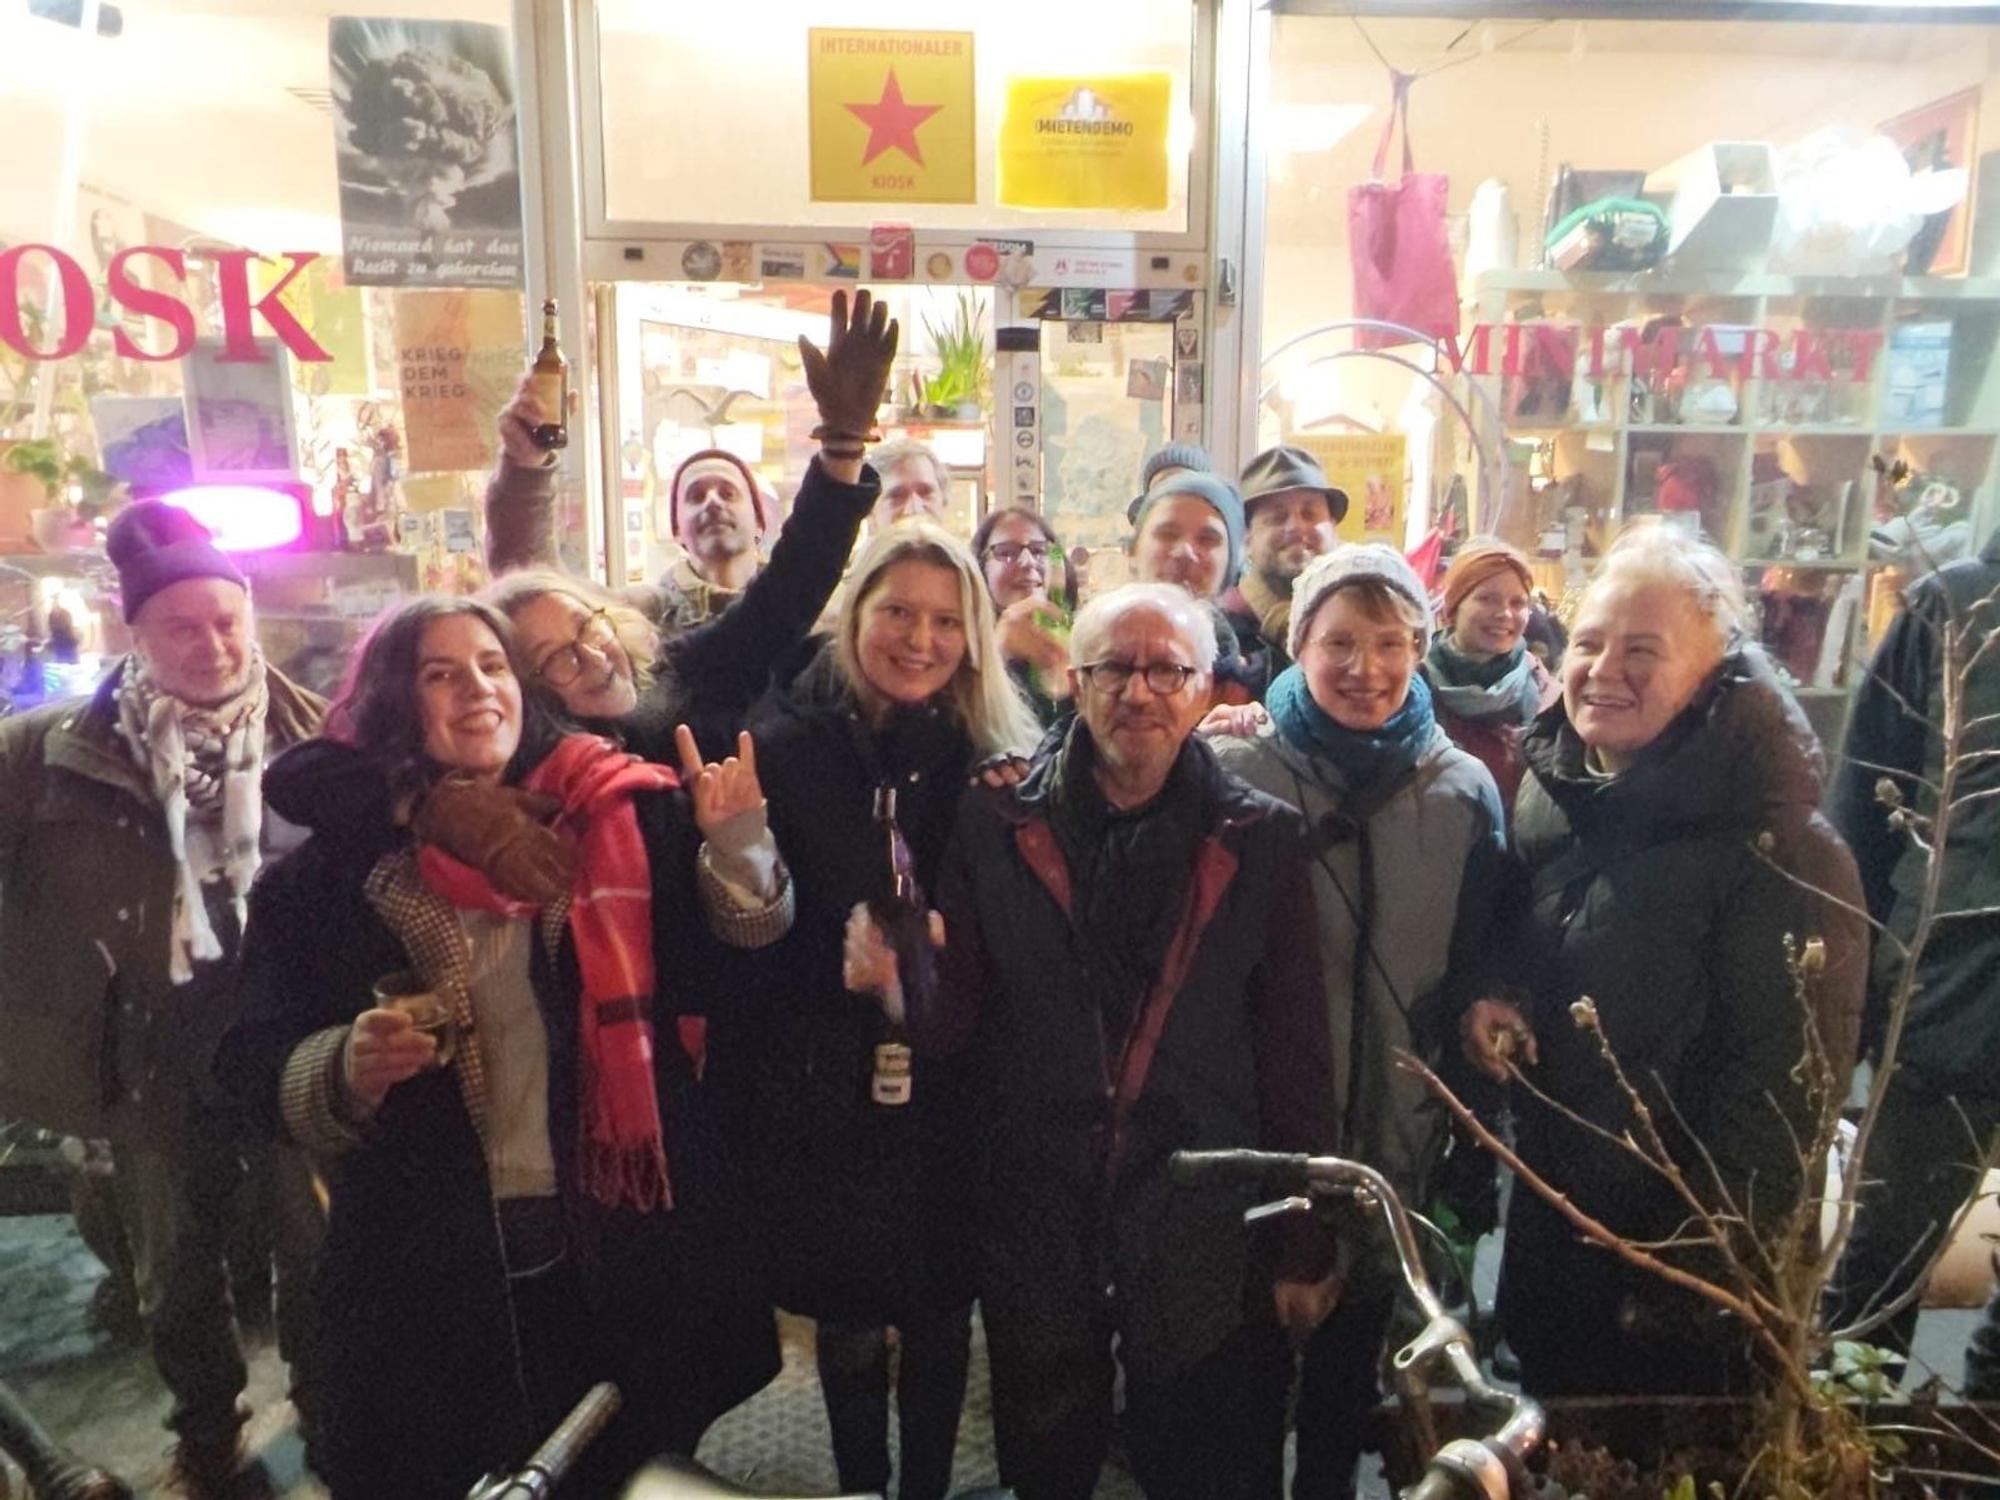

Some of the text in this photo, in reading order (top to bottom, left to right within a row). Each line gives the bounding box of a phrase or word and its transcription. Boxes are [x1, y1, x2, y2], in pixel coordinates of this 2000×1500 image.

[821, 37, 963, 56] INTERNATIONALER
[872, 176, 915, 190] KIOSK
[350, 235, 520, 255] Niemand hat das
[353, 257, 518, 280] Recht zu gehorchen
[0, 243, 335, 362] OSK
[401, 347, 462, 362] KRIEG
[1428, 323, 1884, 382] MINIMARKT
[403, 366, 449, 381] DEM
[405, 384, 466, 399] KRIEG
